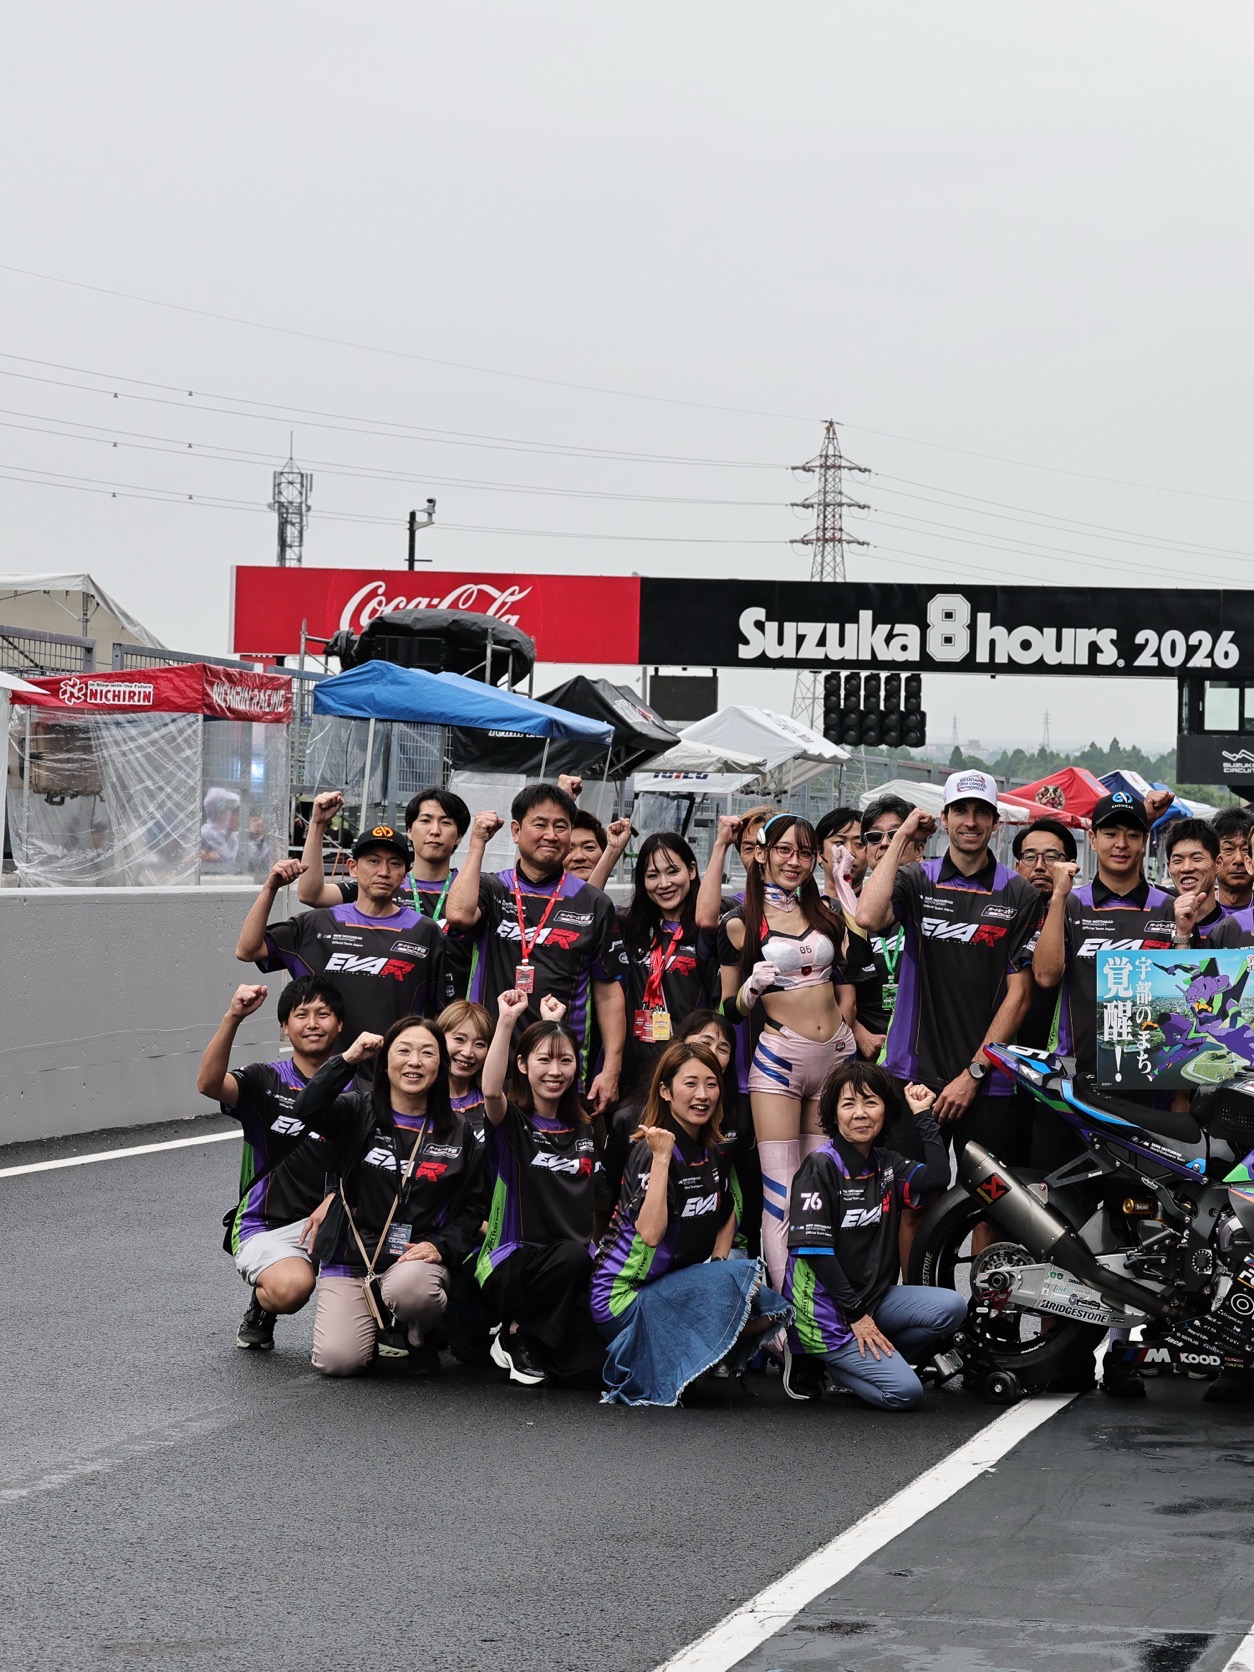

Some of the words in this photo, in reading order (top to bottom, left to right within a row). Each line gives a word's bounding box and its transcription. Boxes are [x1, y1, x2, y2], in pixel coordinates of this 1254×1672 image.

[738, 606, 920, 662] Suzuka
[926, 594, 971, 662] 8
[976, 612, 1118, 665] hours
[1133, 630, 1240, 668] 2026
[89, 688, 151, 703] NICHIRIN
[800, 946, 812, 954] 05
[1103, 956, 1133, 1082] 覚醒！
[1135, 956, 1153, 1082] 宇部のまち、
[681, 1190, 722, 1218] EVA
[801, 1192, 822, 1211] 76
[1040, 1299, 1109, 1323] BRIDGESTONE
[1164, 1336, 1184, 1347] Jack
[1144, 1348, 1171, 1362] M
[1180, 1352, 1221, 1366] KOOD
